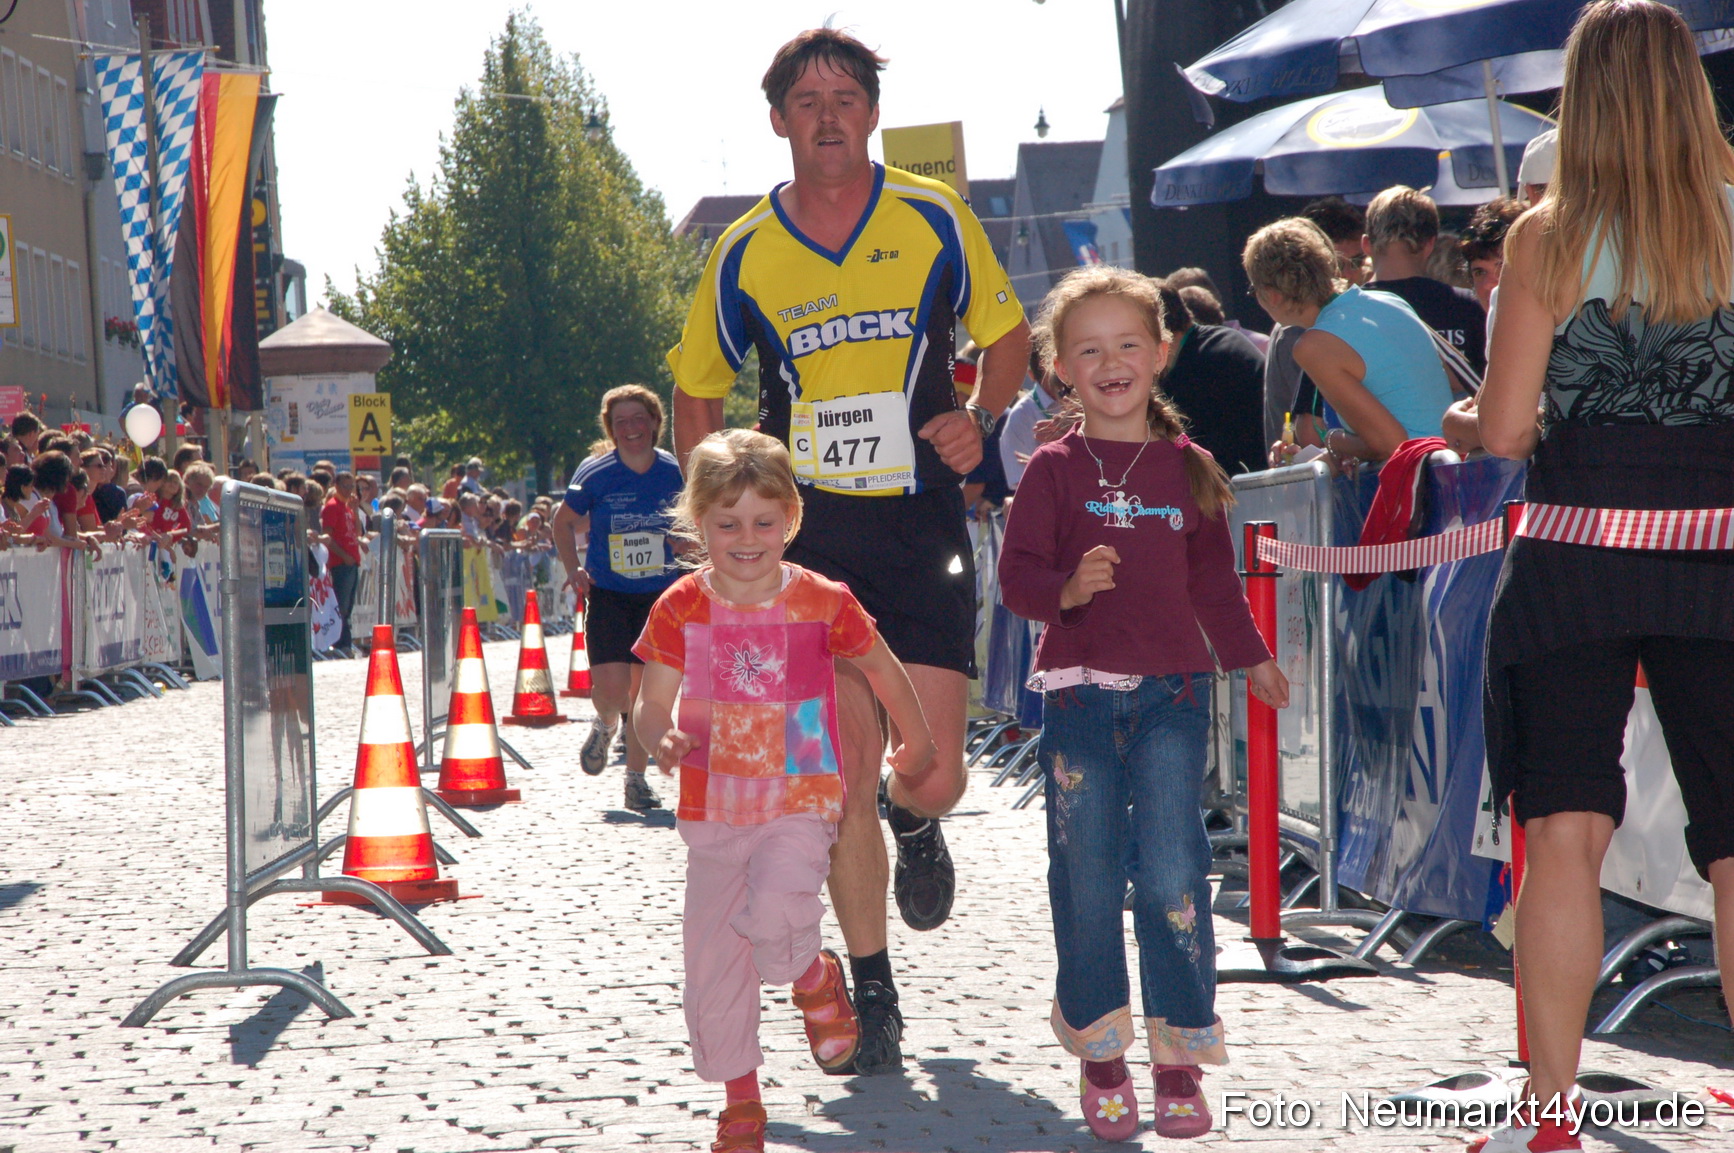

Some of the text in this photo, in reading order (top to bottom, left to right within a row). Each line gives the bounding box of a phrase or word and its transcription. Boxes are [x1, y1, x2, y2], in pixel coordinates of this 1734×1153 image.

[777, 294, 838, 322] TEAM
[788, 309, 915, 358] BOCK
[353, 395, 387, 408] Block
[817, 407, 874, 428] Jürgen
[358, 412, 382, 442] A
[796, 438, 809, 452] C
[823, 436, 881, 467] 477
[868, 472, 912, 484] PFLEIDERER
[1085, 500, 1181, 519] Riding Champion
[623, 537, 650, 548] Angela
[613, 551, 620, 559] C
[626, 551, 652, 566] 107
